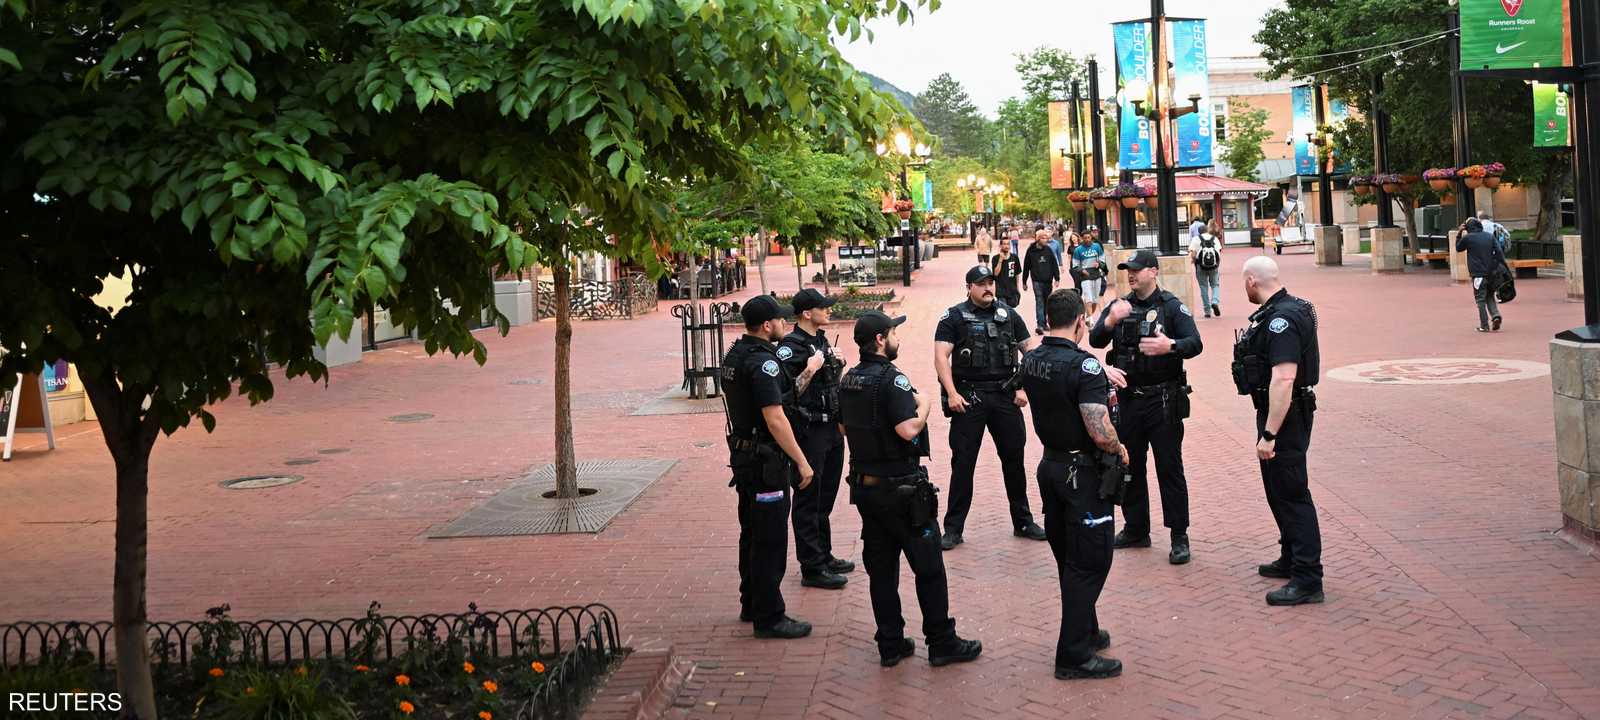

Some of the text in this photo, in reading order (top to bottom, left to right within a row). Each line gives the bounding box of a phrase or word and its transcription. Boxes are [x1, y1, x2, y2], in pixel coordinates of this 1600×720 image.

[1133, 26, 1146, 80] OULDER
[1193, 24, 1206, 77] OULDER
[1025, 358, 1052, 380] POLICE
